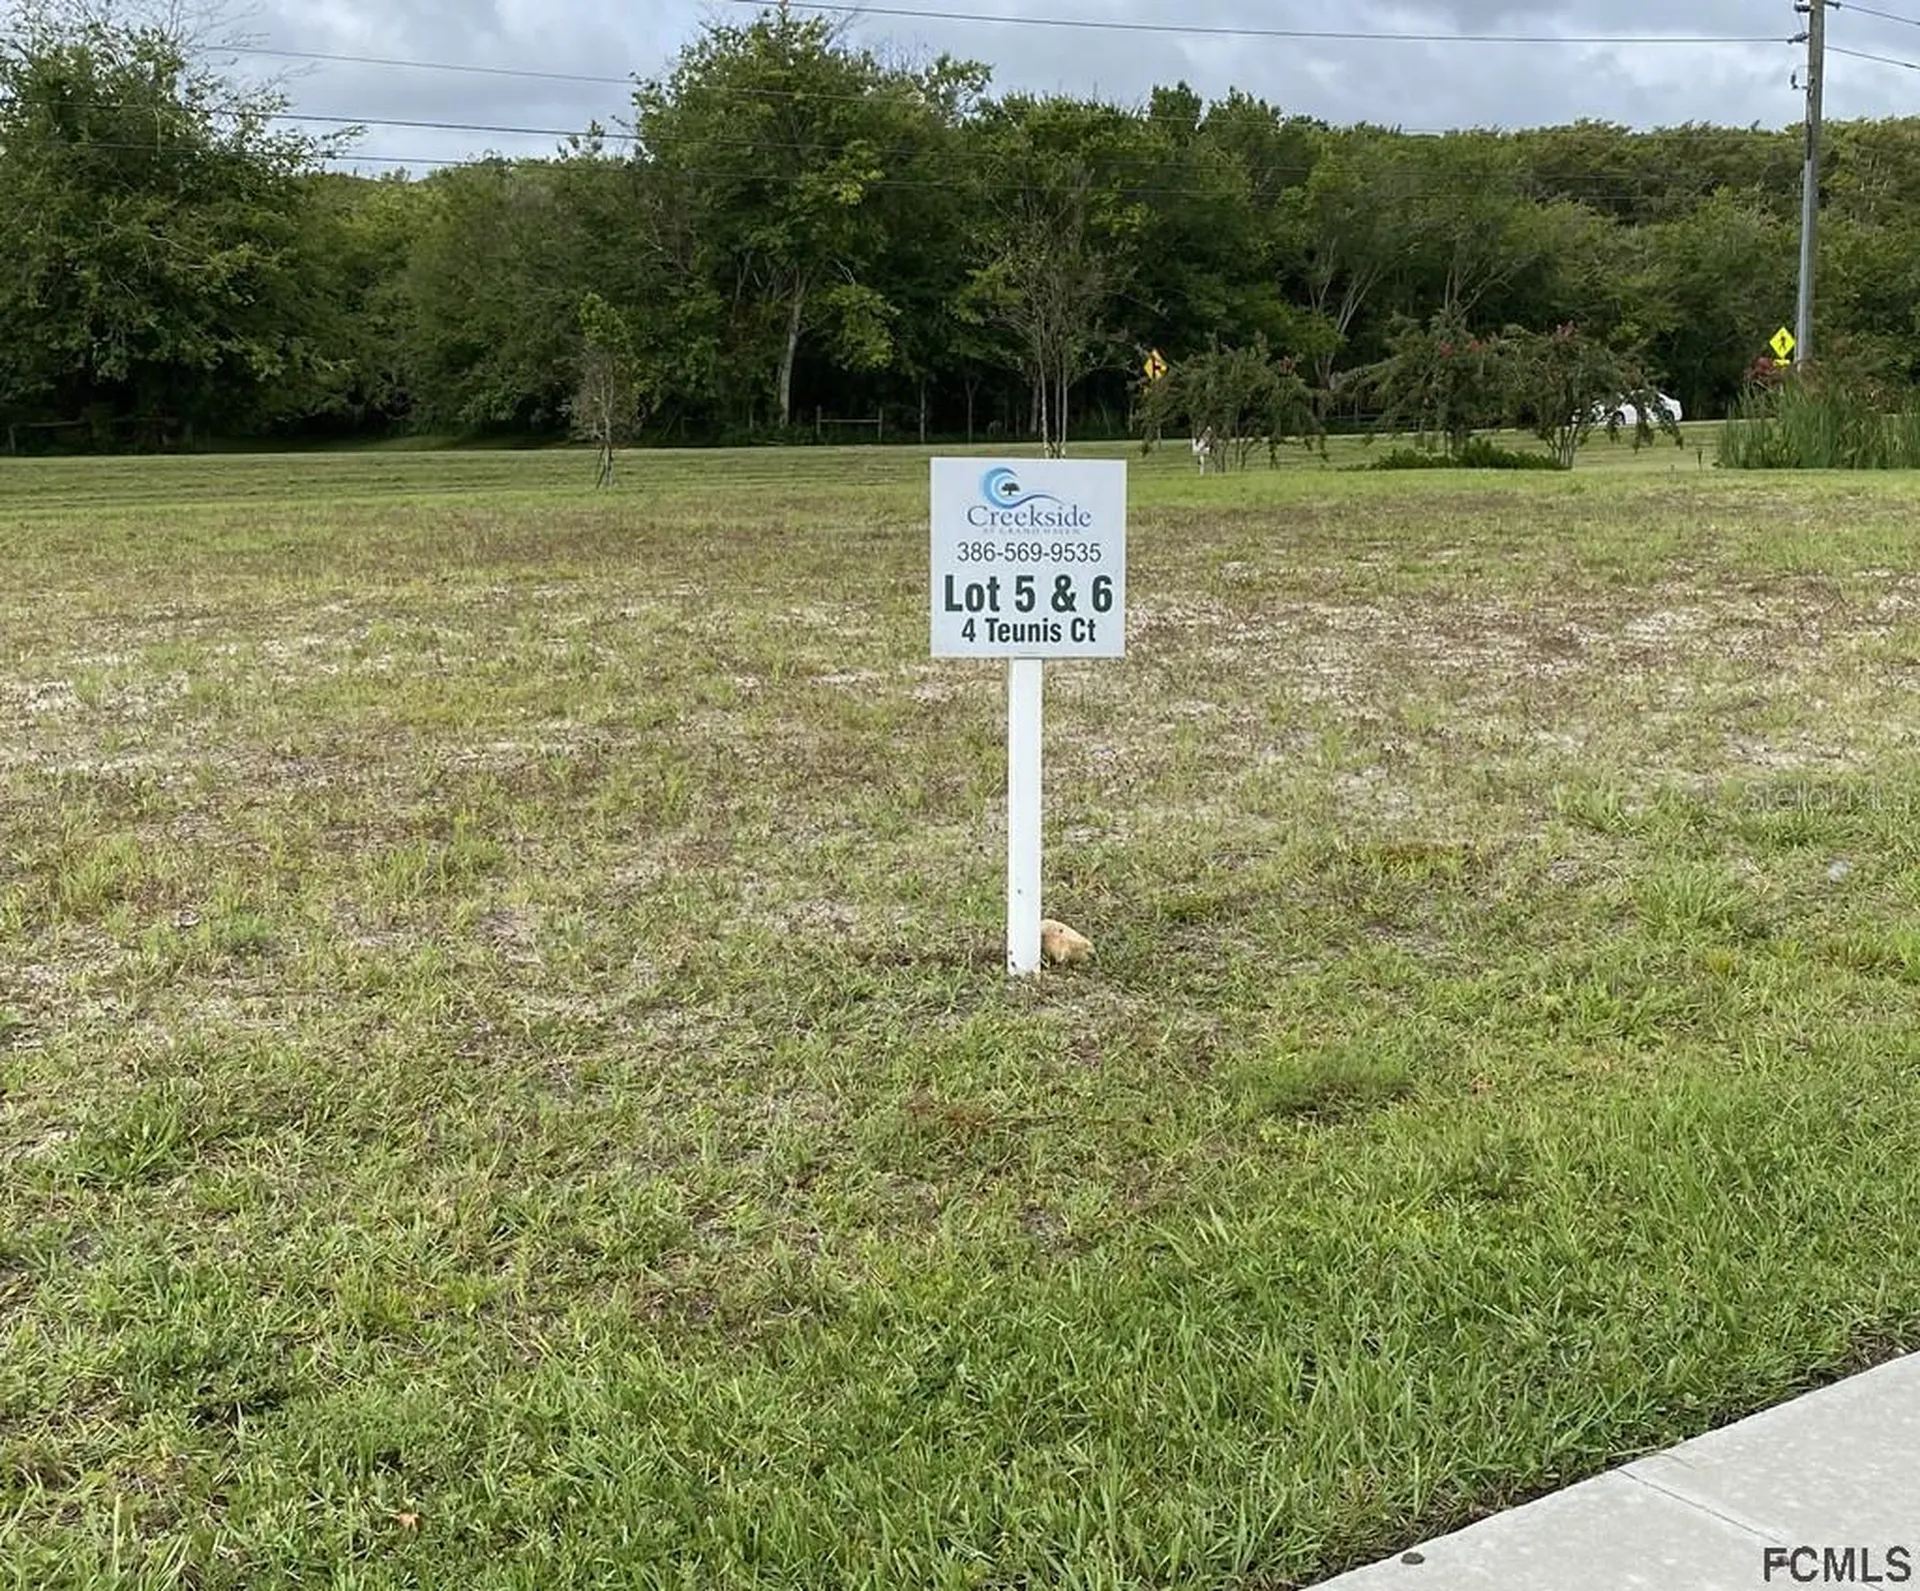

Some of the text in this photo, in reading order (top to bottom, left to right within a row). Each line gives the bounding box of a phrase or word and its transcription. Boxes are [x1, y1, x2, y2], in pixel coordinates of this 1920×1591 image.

[967, 504, 1091, 527] Creekside
[957, 541, 1102, 563] 386-569-9535
[944, 574, 1113, 613] Lot 5 & 6
[961, 618, 1096, 643] 4 Teunis Ct
